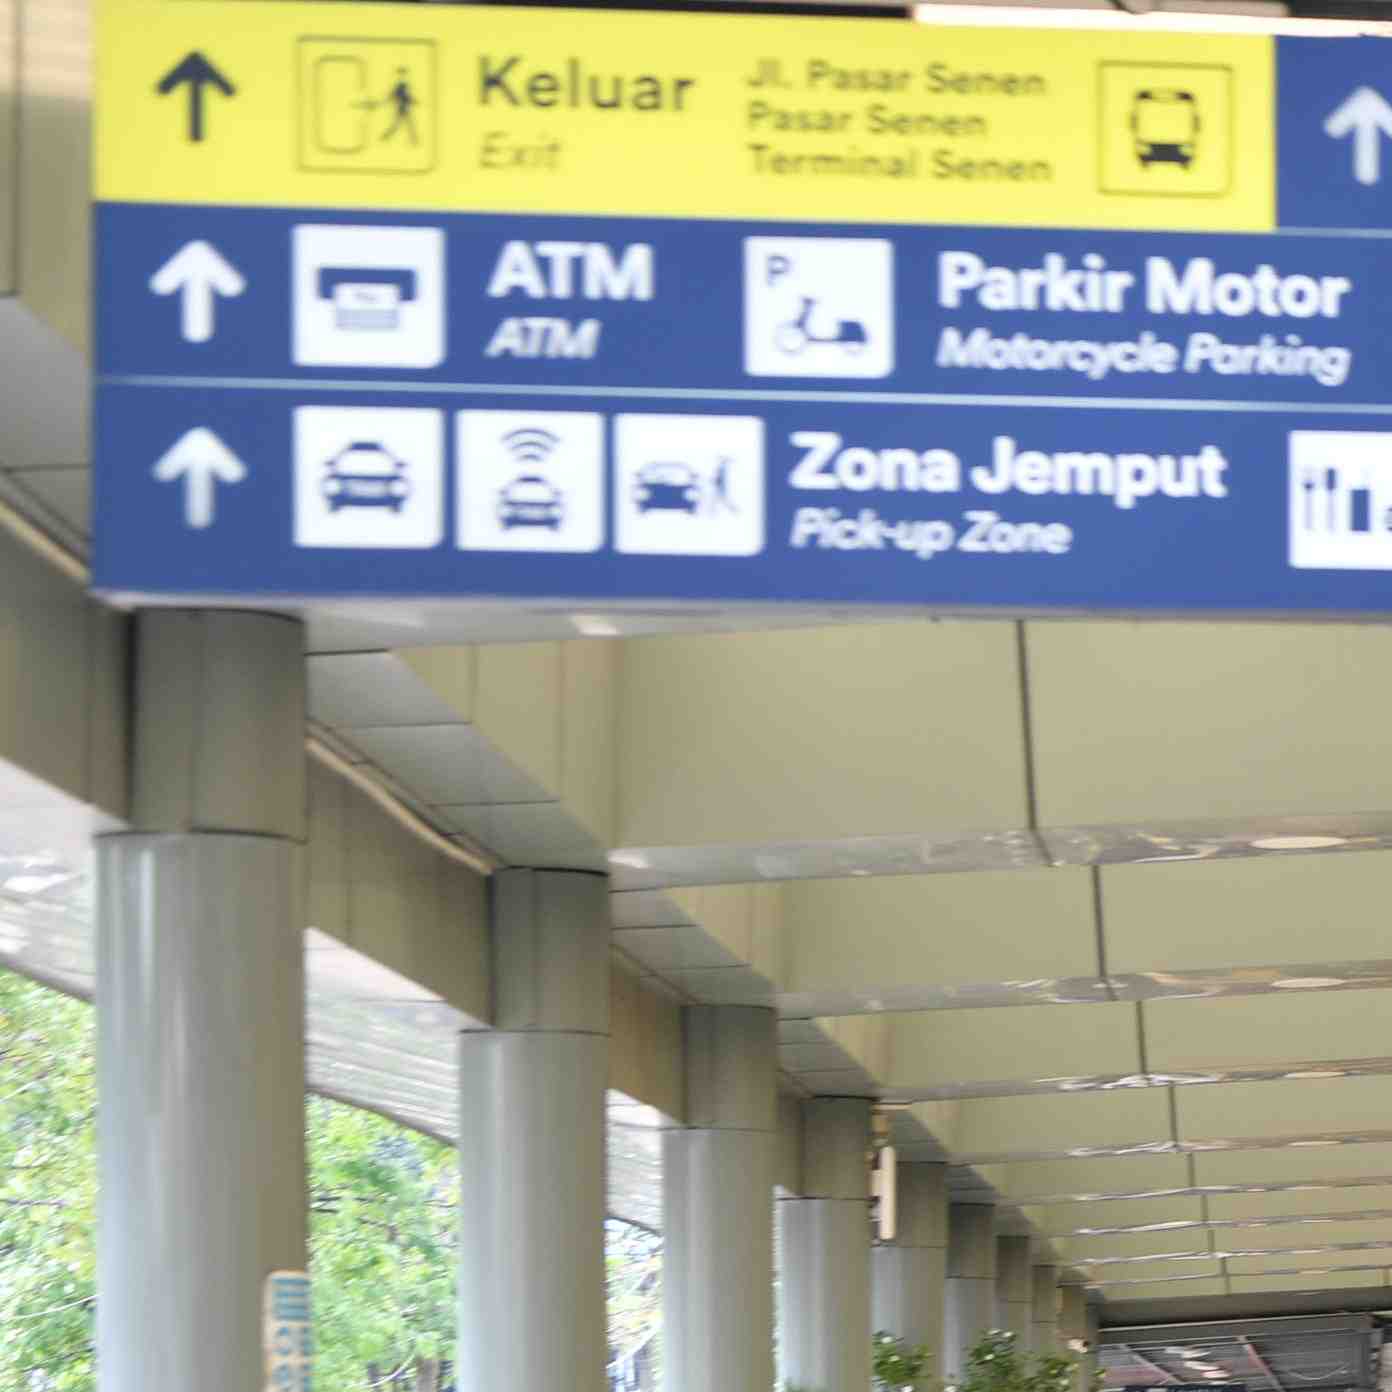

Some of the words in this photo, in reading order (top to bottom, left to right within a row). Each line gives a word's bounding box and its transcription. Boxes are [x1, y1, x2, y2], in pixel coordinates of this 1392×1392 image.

[479, 56, 694, 111] Keluar
[746, 59, 792, 88] Jl.
[808, 60, 911, 93] Pasar
[926, 63, 1045, 96] Senen
[748, 99, 852, 133] Pasar
[867, 104, 985, 136] Senen
[479, 131, 561, 169] Exit
[748, 143, 915, 179] Terminal
[932, 149, 1051, 181] Senen
[488, 241, 653, 300] ATM
[939, 251, 1134, 312] Parkir
[1146, 257, 1351, 317] Motor
[486, 317, 599, 358] ATM
[937, 327, 1179, 379] Motorcycle
[1184, 332, 1351, 386] Parking
[789, 432, 960, 492] Zona
[971, 436, 1227, 509] Jemput
[791, 507, 954, 558] Pick-up
[957, 511, 1072, 554] Zone
